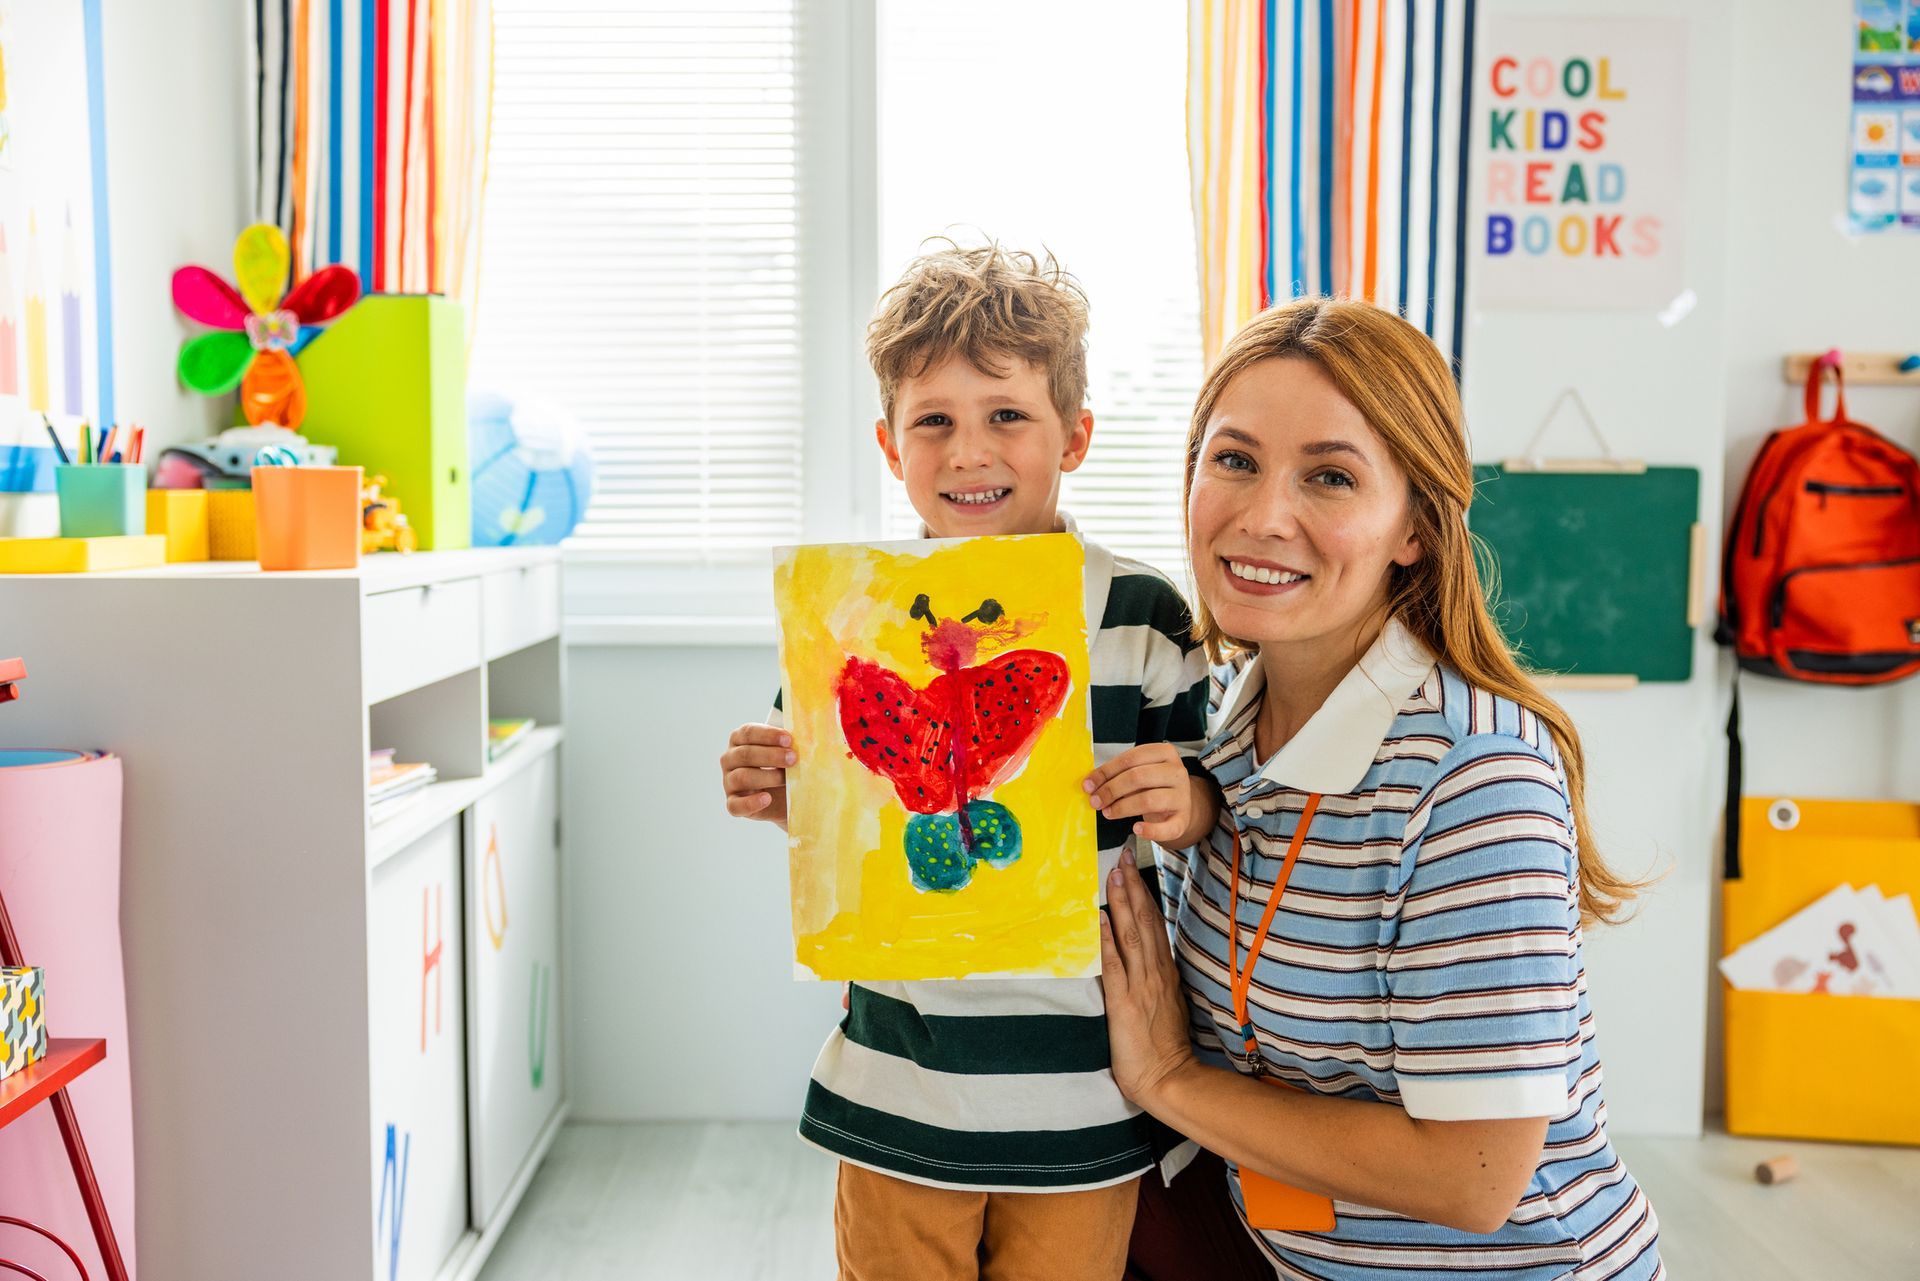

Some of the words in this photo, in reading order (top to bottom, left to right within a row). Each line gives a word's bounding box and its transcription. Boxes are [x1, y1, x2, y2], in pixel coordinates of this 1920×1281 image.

[1490, 57, 1627, 100] COOL
[1490, 110, 1607, 152] KIDS
[1487, 162, 1626, 205] READ
[1485, 214, 1662, 258] BOOKS
[420, 883, 443, 1054] H
